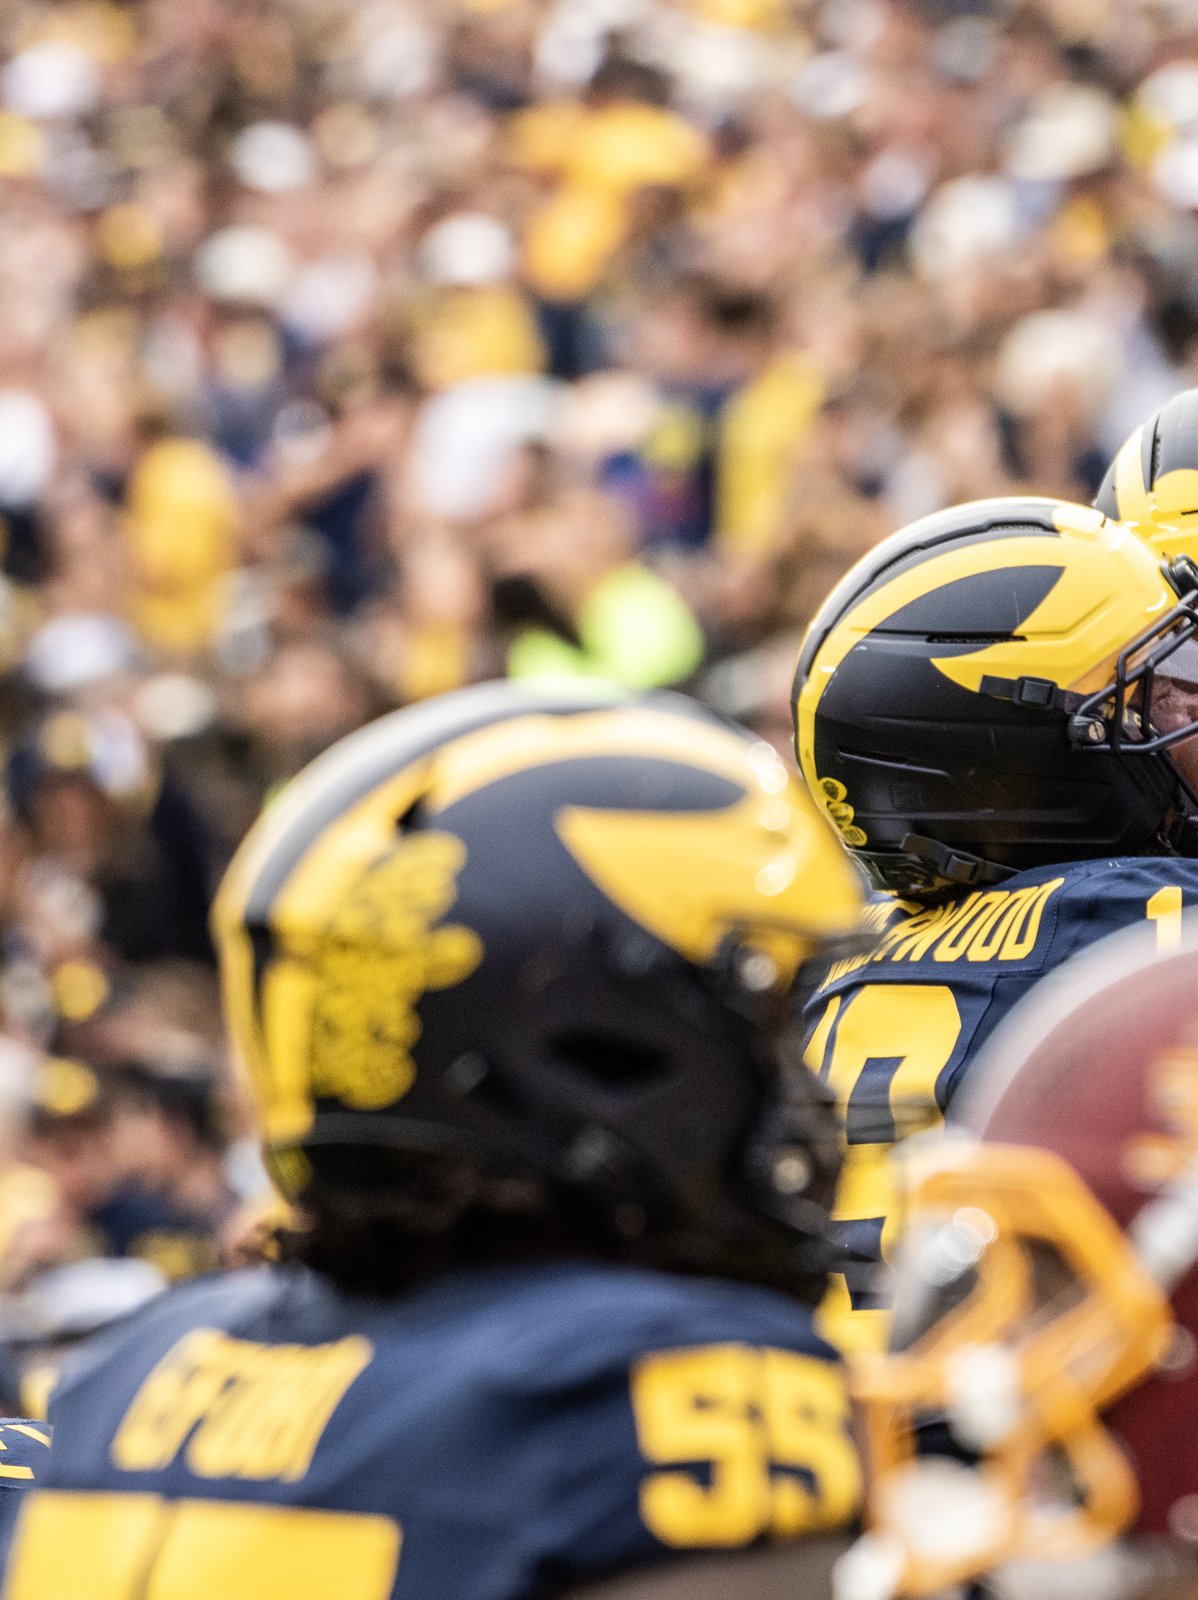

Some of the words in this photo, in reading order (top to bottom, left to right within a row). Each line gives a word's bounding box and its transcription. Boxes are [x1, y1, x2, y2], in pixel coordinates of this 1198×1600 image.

[819, 877, 1066, 993] RWOOD
[803, 984, 963, 1358] 9
[630, 1342, 863, 1549] 55
